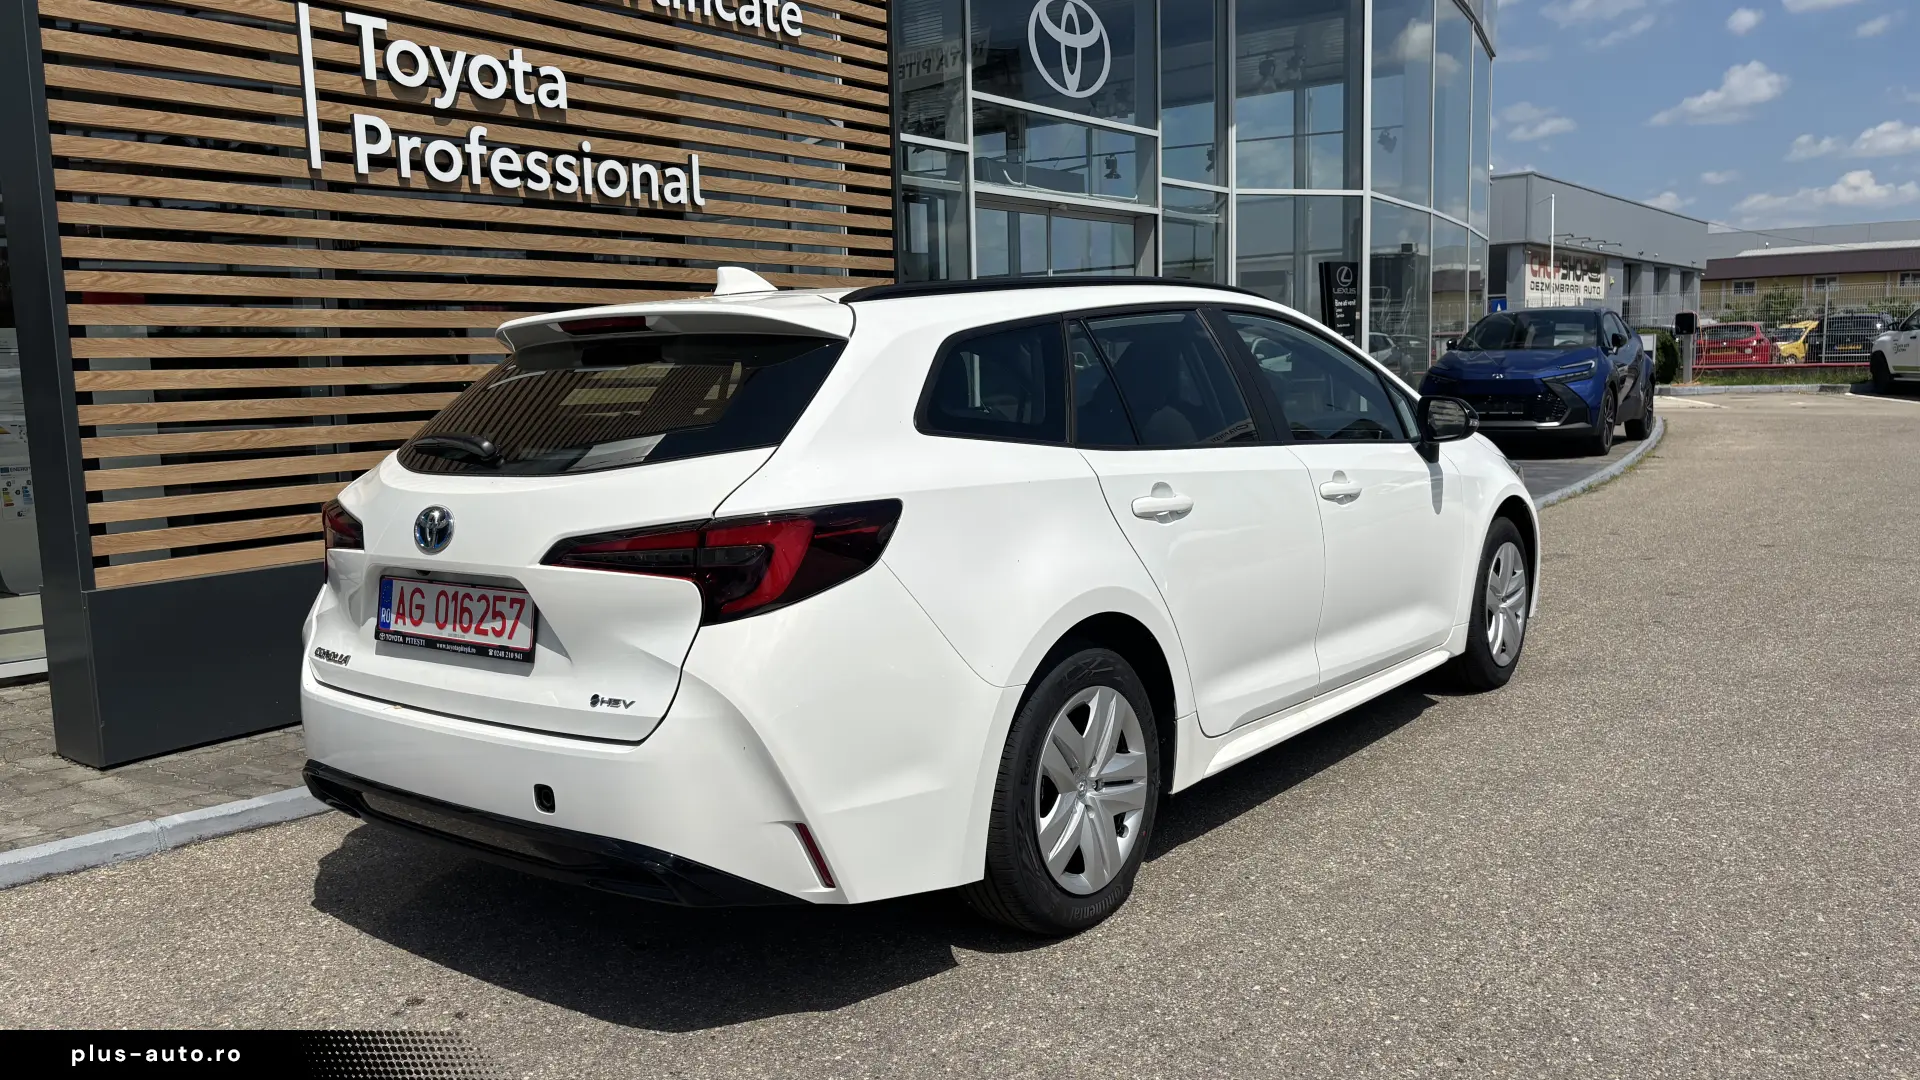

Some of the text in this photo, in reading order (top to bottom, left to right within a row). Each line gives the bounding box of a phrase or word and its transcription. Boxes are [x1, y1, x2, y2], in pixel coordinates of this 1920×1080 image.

[344, 12, 569, 111] Toyota
[352, 114, 706, 208] Professional
[1332, 287, 1356, 295] LEXUS
[1583, 285, 1601, 295] AUTO
[380, 607, 392, 623] RO
[394, 585, 526, 640] AG 016257
[385, 633, 403, 643] TOYOTA
[493, 650, 505, 658] 0248
[505, 651, 514, 659] 210
[599, 696, 637, 710] HEV
